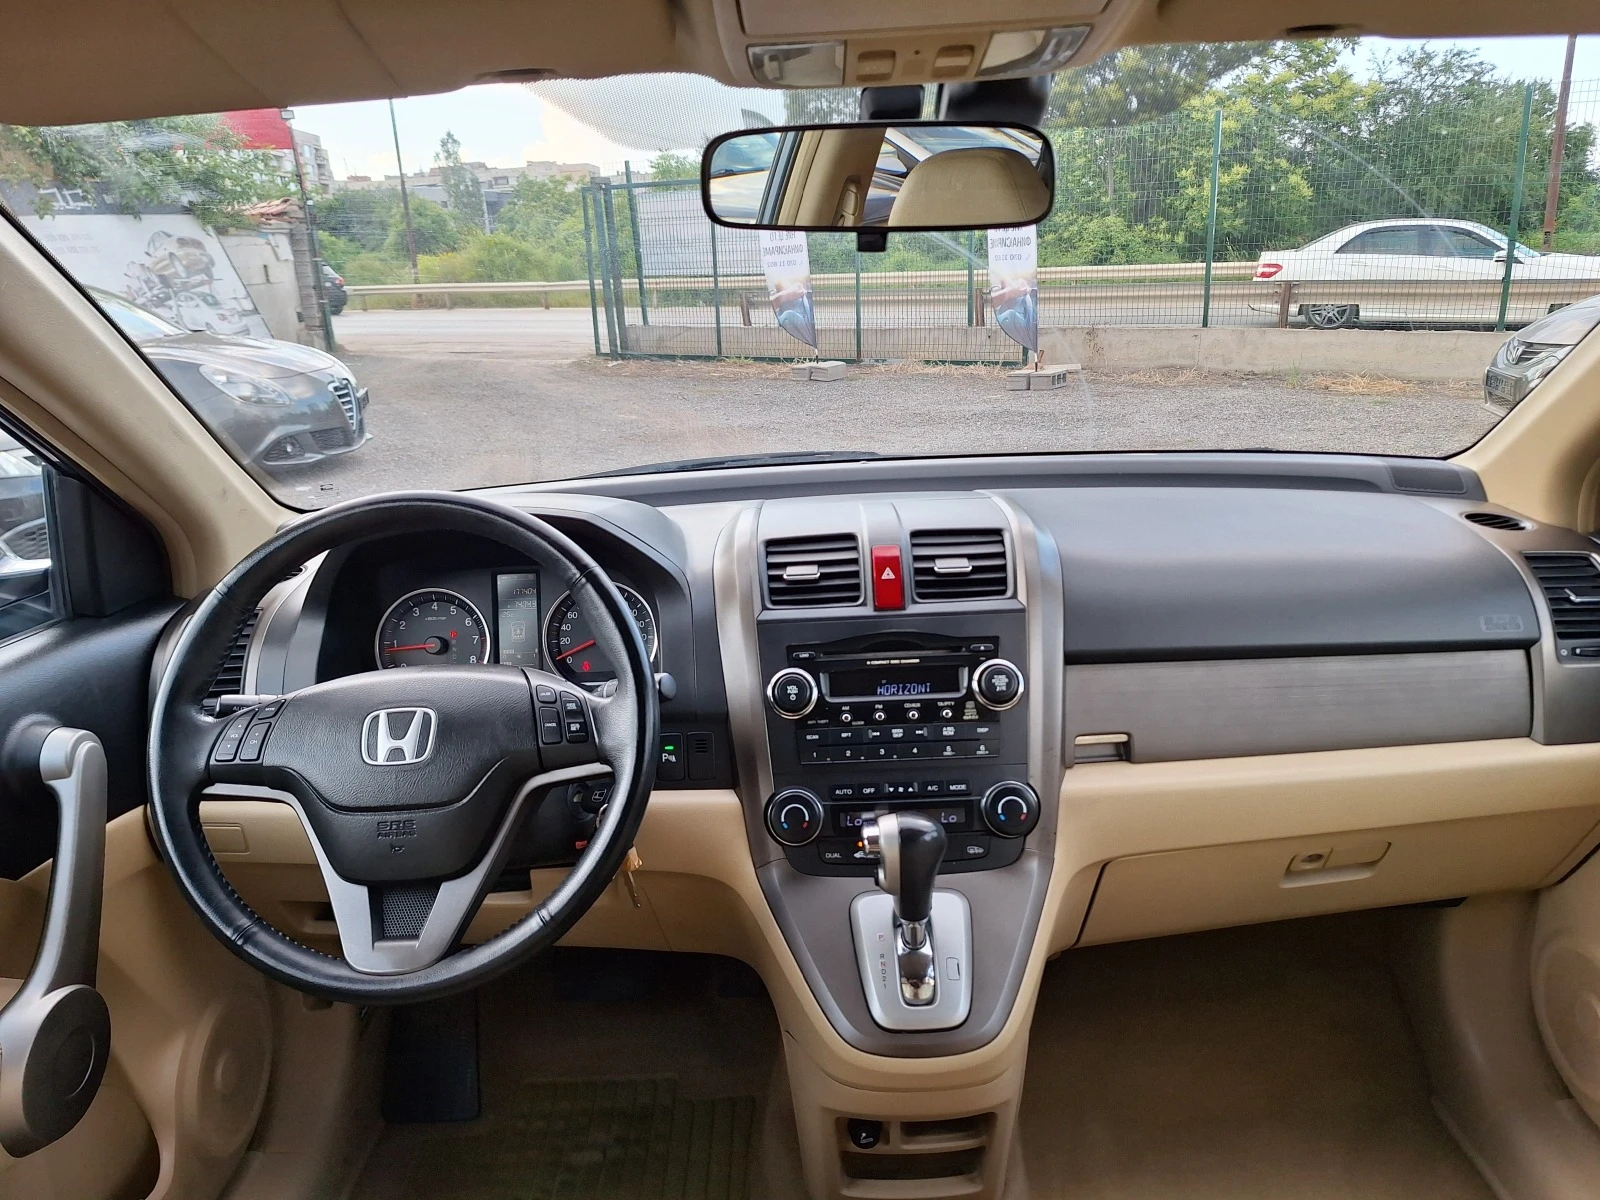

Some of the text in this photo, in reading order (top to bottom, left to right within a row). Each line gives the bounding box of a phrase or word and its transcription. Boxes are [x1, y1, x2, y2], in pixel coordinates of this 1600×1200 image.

[431, 602, 438, 610] 4
[450, 606, 457, 615] 5
[412, 607, 420, 617] 3
[399, 621, 406, 630] 2
[465, 618, 472, 627] 6
[472, 635, 479, 645] 7
[560, 637, 571, 645] 20
[469, 655, 477, 664] 8
[566, 656, 573, 664] 0
